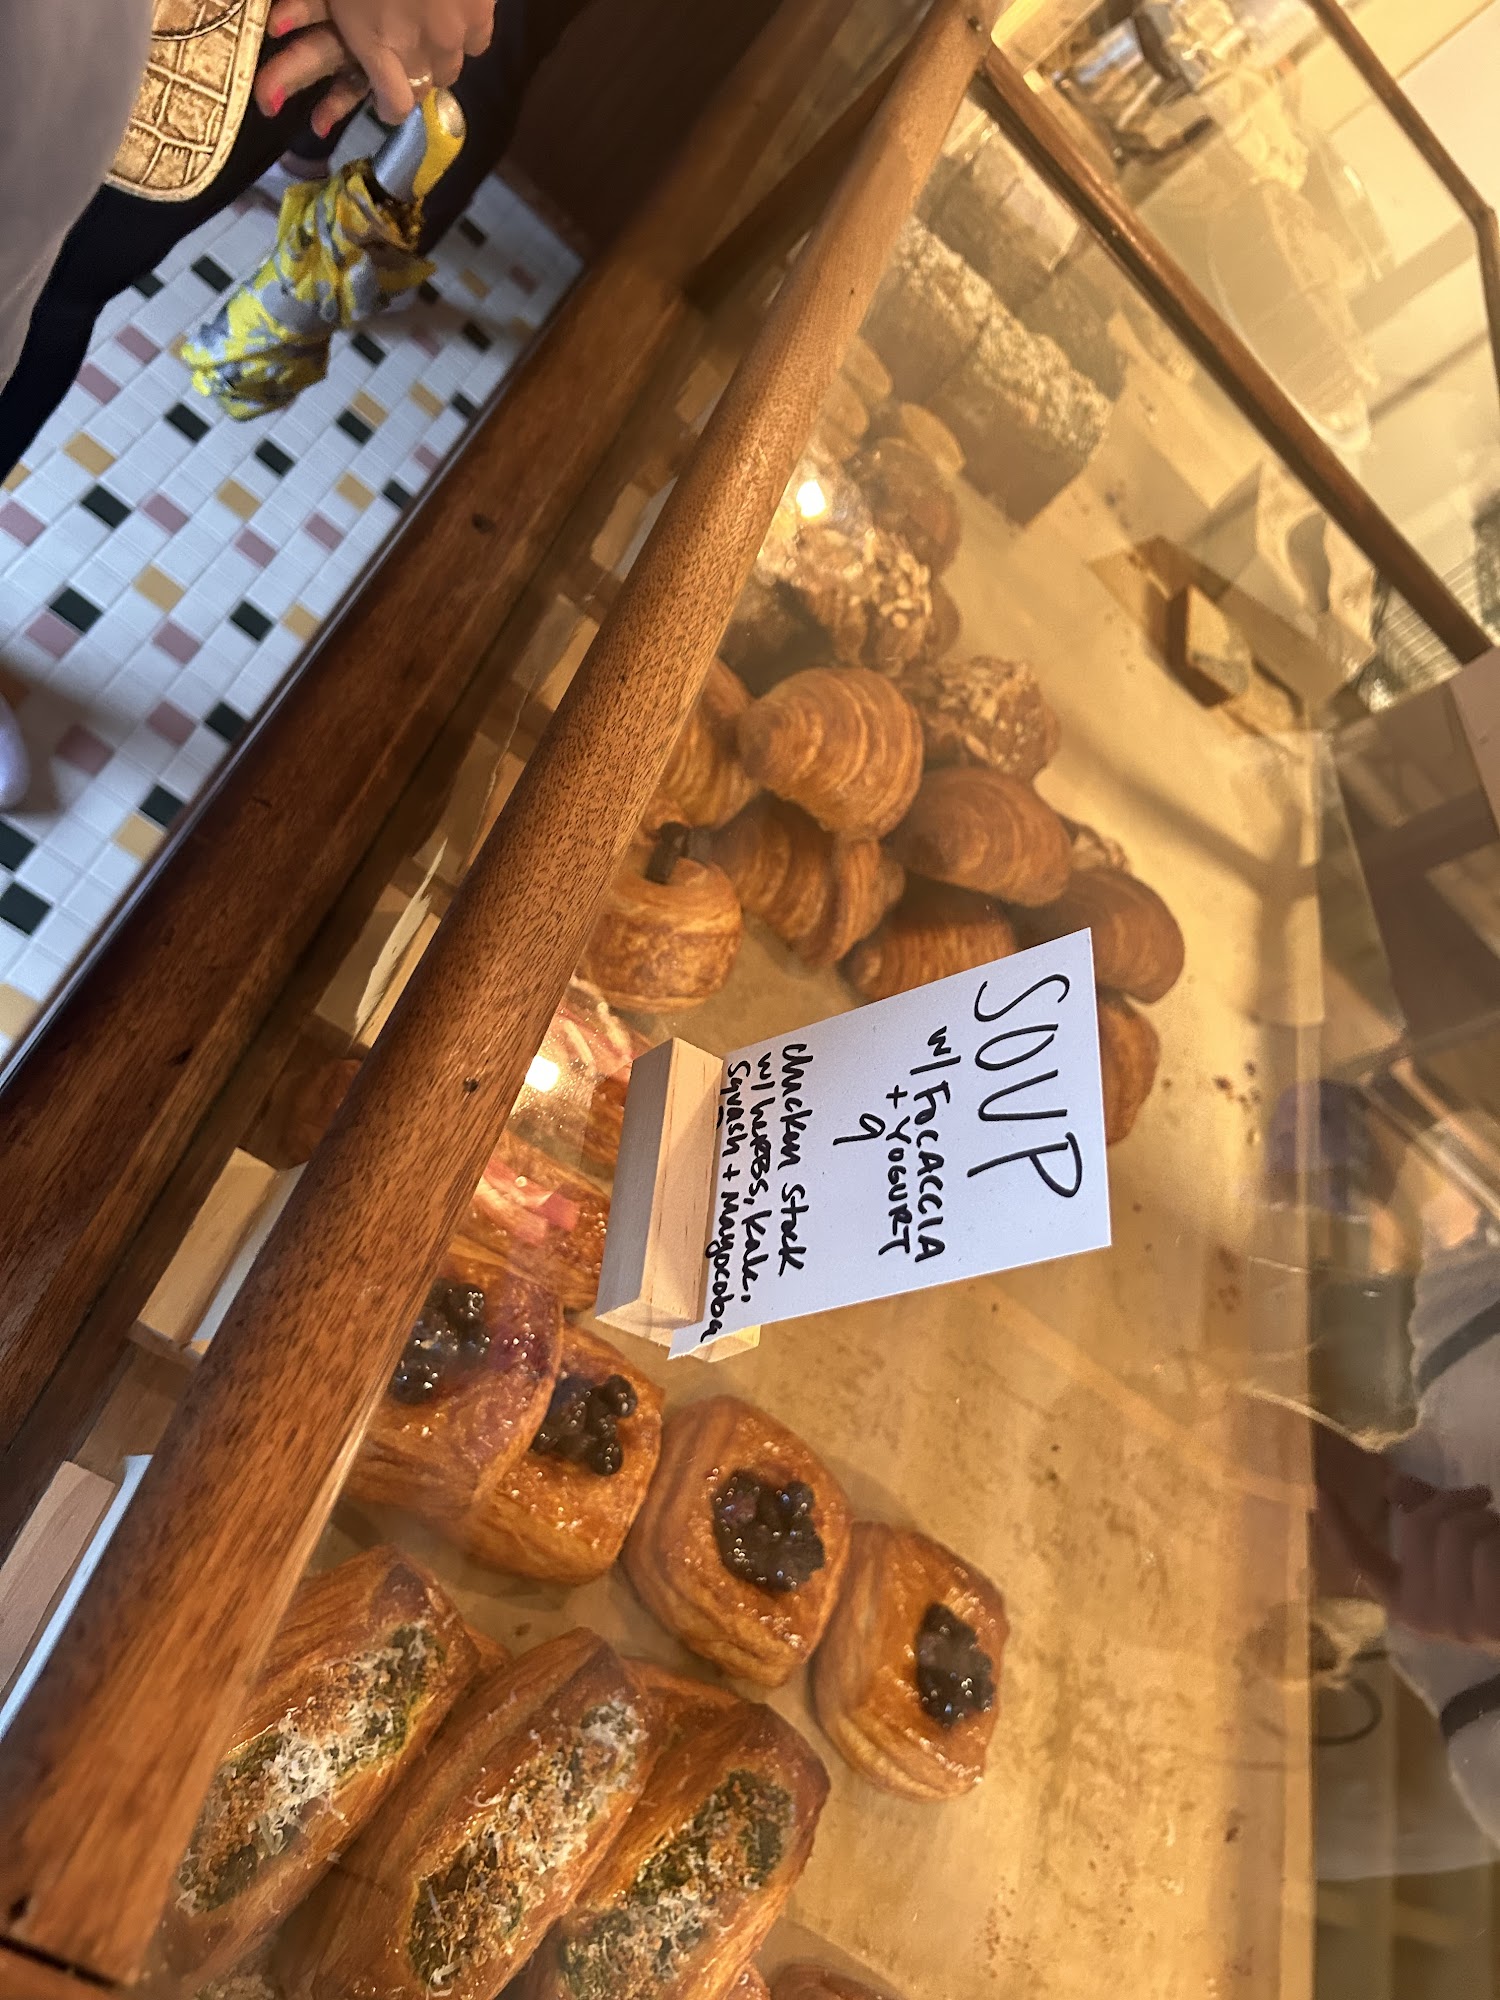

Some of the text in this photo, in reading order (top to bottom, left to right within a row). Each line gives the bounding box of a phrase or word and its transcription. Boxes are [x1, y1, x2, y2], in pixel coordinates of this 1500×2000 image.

[751, 1051, 776, 1091] w/
[777, 1043, 814, 1171] chicken
[833, 1112, 886, 1146] 9
[967, 973, 1083, 1198] SOUP
[722, 1163, 741, 1182] +
[878, 1084, 912, 1256] + YOGURT
[909, 1025, 961, 1263] w/ FOCACCIA
